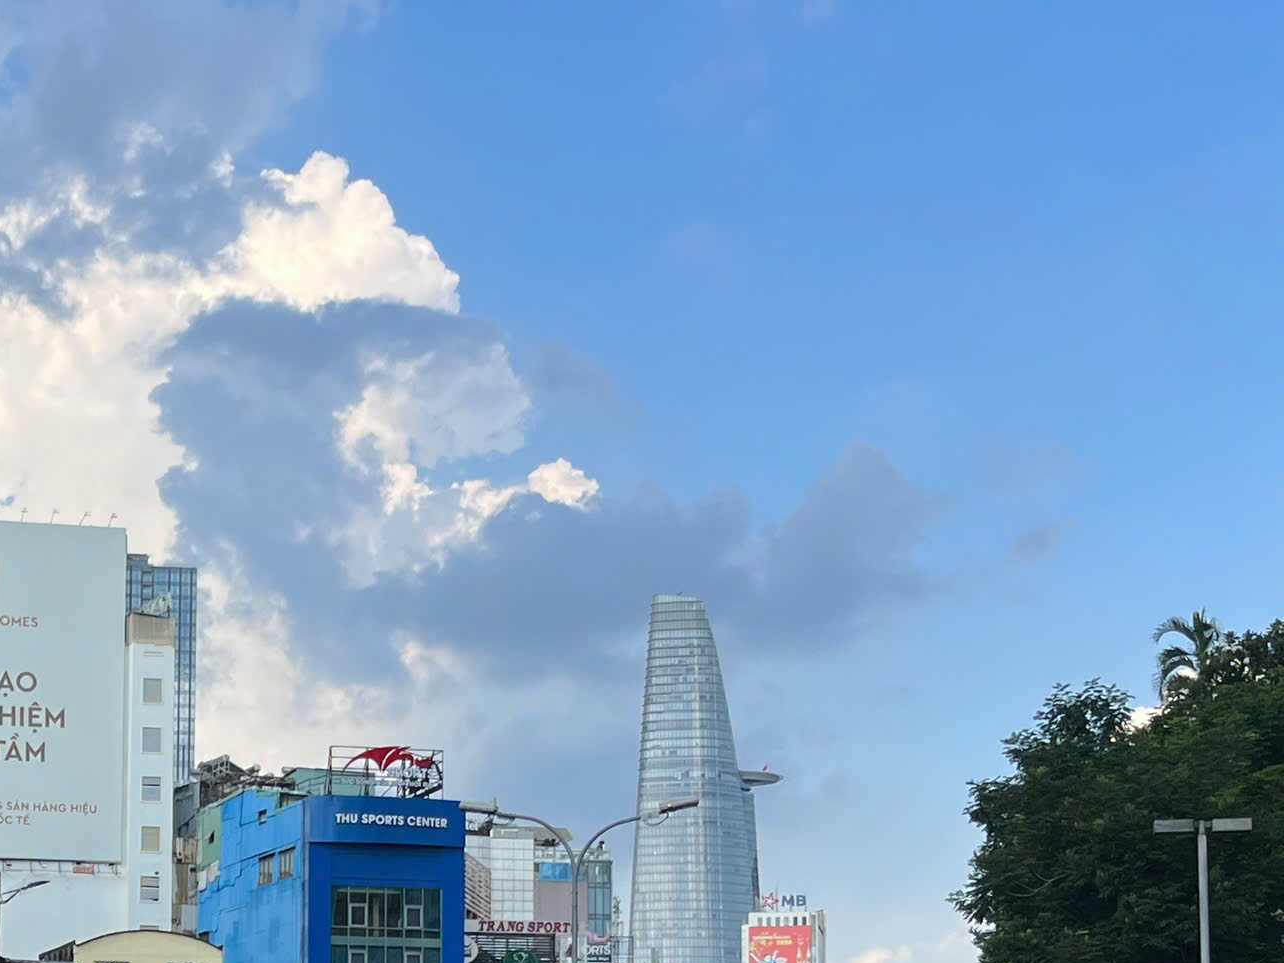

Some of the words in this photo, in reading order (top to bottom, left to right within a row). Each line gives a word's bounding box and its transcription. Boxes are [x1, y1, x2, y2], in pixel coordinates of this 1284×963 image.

[335, 813, 358, 824] THU
[361, 814, 405, 826] SPORTS
[406, 816, 448, 829] CENTER
[781, 895, 807, 907] MB
[478, 921, 525, 933] TRANG
